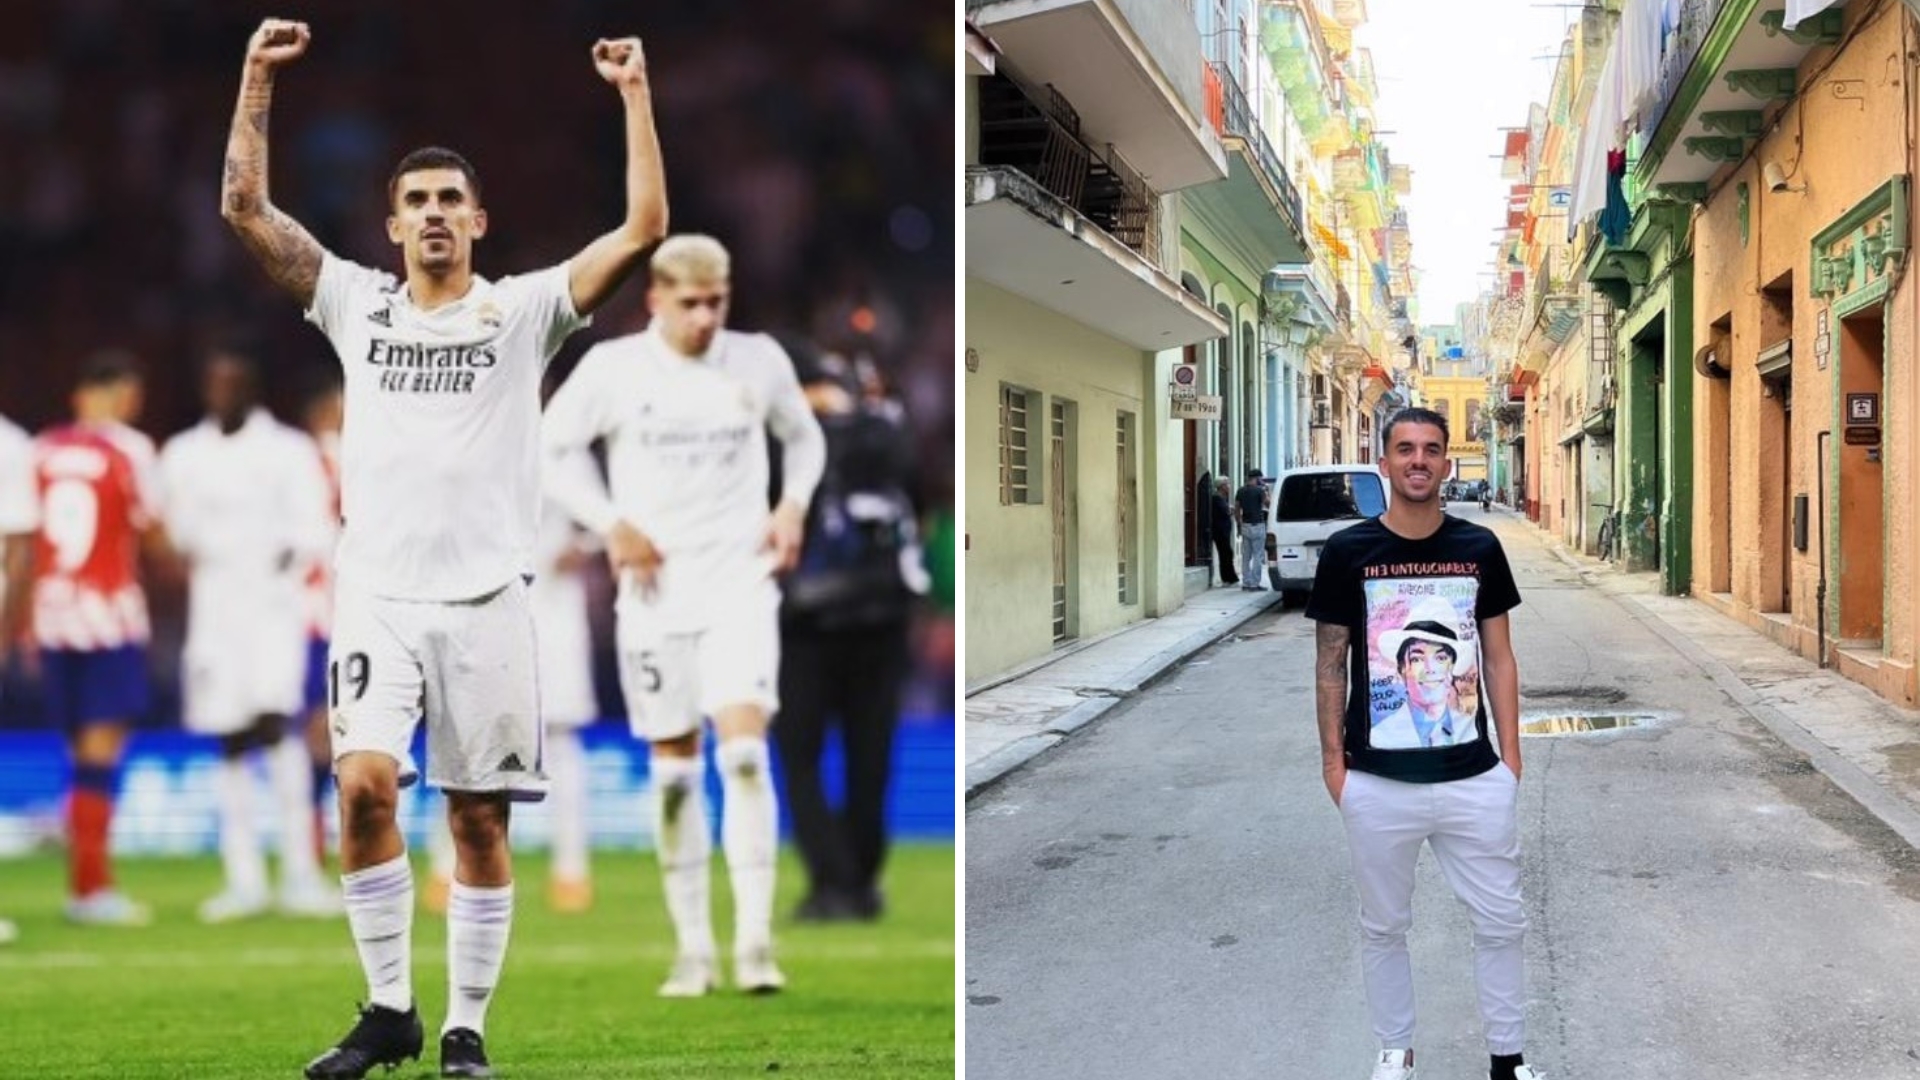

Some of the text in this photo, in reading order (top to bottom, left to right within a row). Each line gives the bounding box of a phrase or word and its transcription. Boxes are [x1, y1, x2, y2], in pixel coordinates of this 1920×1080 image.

[367, 338, 497, 368] Emirates
[412, 370, 475, 393] BETTER
[44, 478, 97, 573] 9
[331, 652, 370, 708] 19
